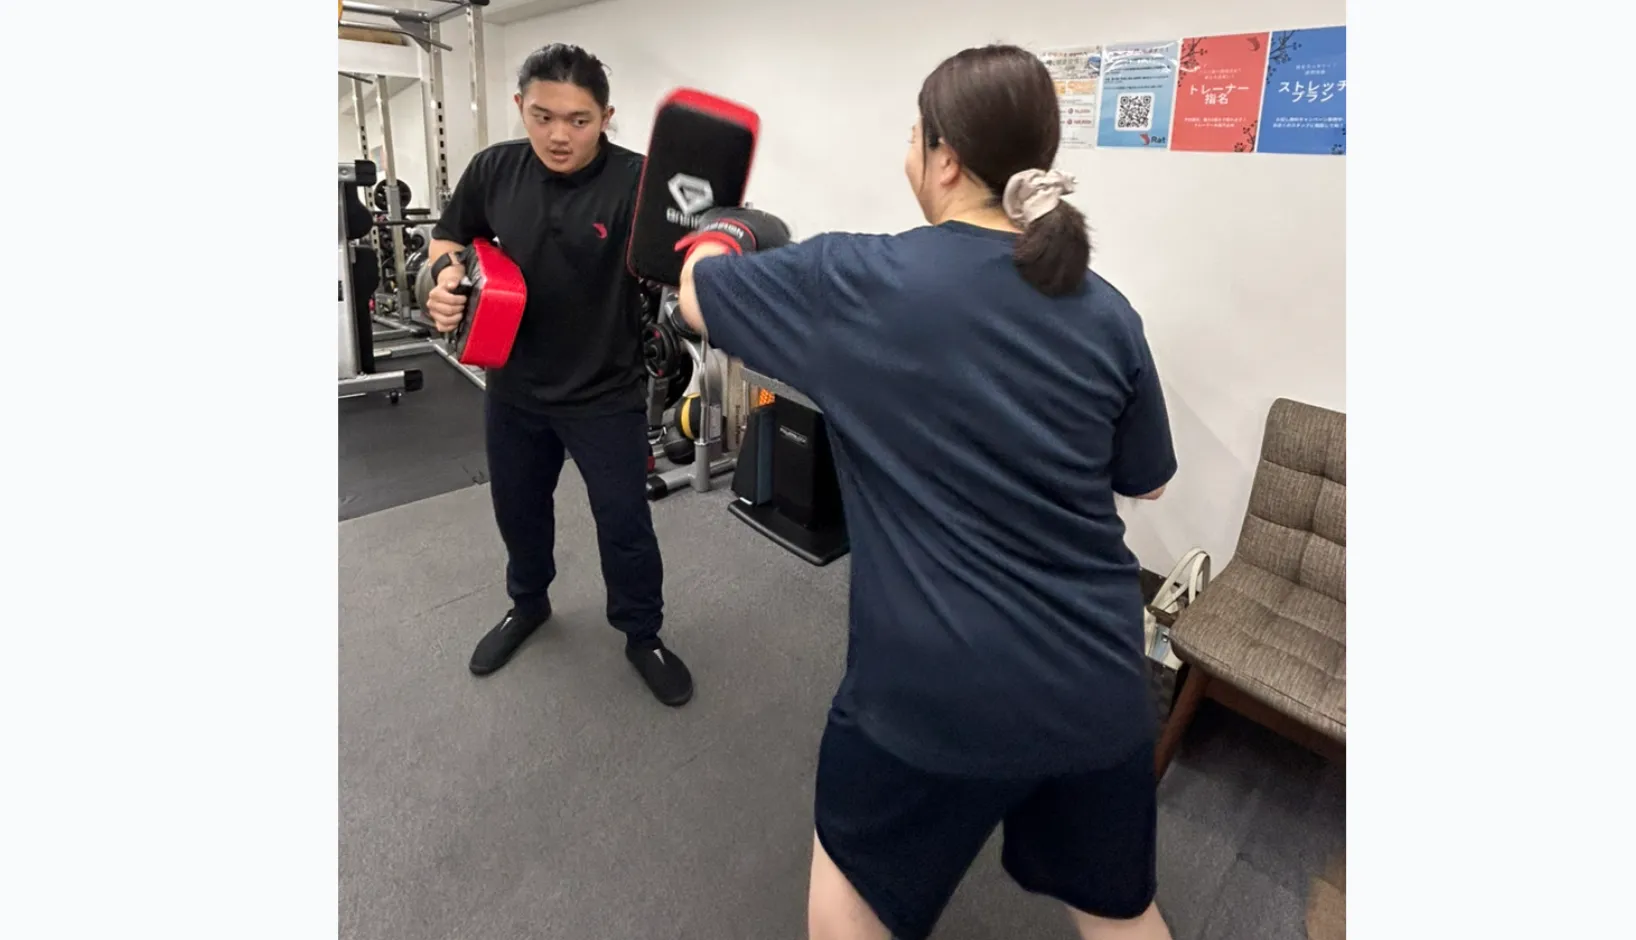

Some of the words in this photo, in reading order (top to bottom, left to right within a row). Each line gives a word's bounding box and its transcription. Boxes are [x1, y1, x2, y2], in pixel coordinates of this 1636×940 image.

[1189, 83, 1250, 96] トレーナー
[1278, 79, 1346, 93] ストレッチ
[1204, 93, 1229, 105] 指名
[1151, 135, 1166, 144] Rat
